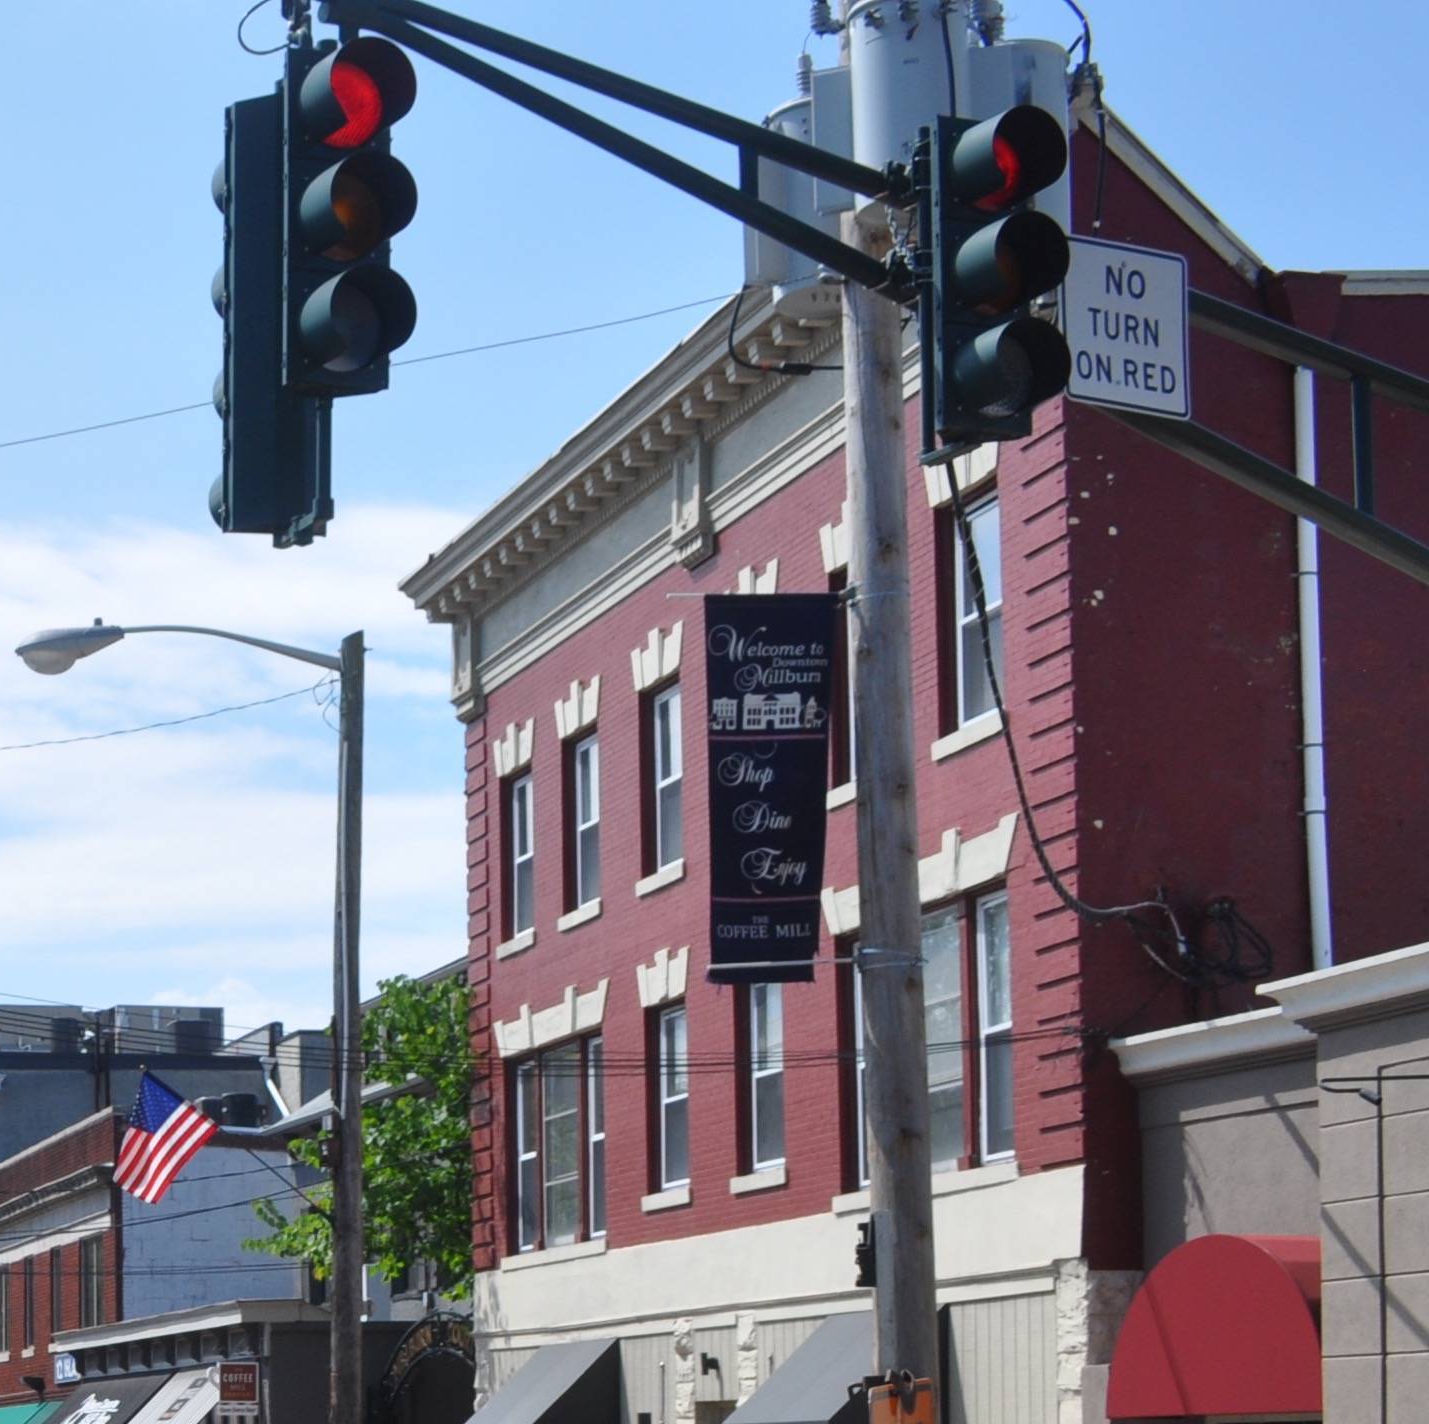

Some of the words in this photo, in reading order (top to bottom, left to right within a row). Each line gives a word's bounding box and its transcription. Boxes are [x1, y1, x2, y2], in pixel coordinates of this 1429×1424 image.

[1105, 264, 1146, 300] NO
[1087, 307, 1159, 348] TURN
[1076, 350, 1112, 384] ON
[1123, 358, 1177, 394] RED
[708, 624, 806, 662] Welcome
[810, 643, 826, 656] to
[772, 657, 829, 668] Downtown
[717, 752, 776, 792] Shop
[732, 800, 792, 834] Dine
[741, 847, 808, 886] Enjoy
[717, 924, 770, 939] COFFEE
[775, 923, 812, 937] MILL
[752, 916, 770, 925] THE
